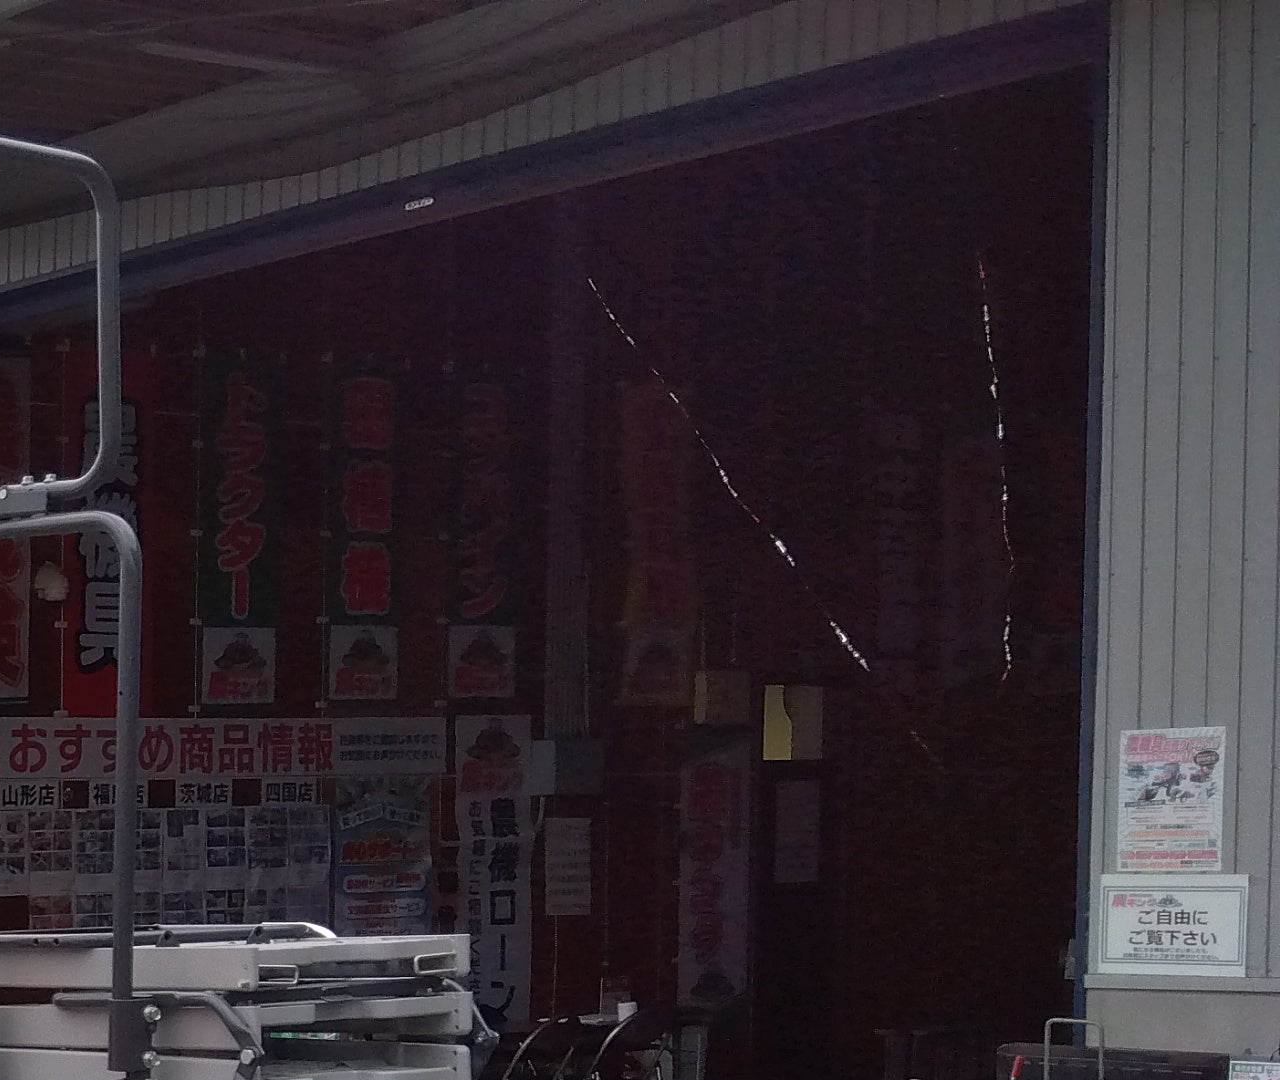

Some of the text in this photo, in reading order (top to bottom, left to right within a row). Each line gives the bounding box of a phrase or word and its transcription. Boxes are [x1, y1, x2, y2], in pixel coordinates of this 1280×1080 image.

[9, 722, 333, 774] おすすめ商品情報
[2, 784, 56, 807] 山形店
[180, 783, 230, 804] 茨城店
[266, 782, 314, 803] 四国店
[1138, 910, 1209, 926] ご自由に
[1128, 930, 1218, 946] ご覧下さい
